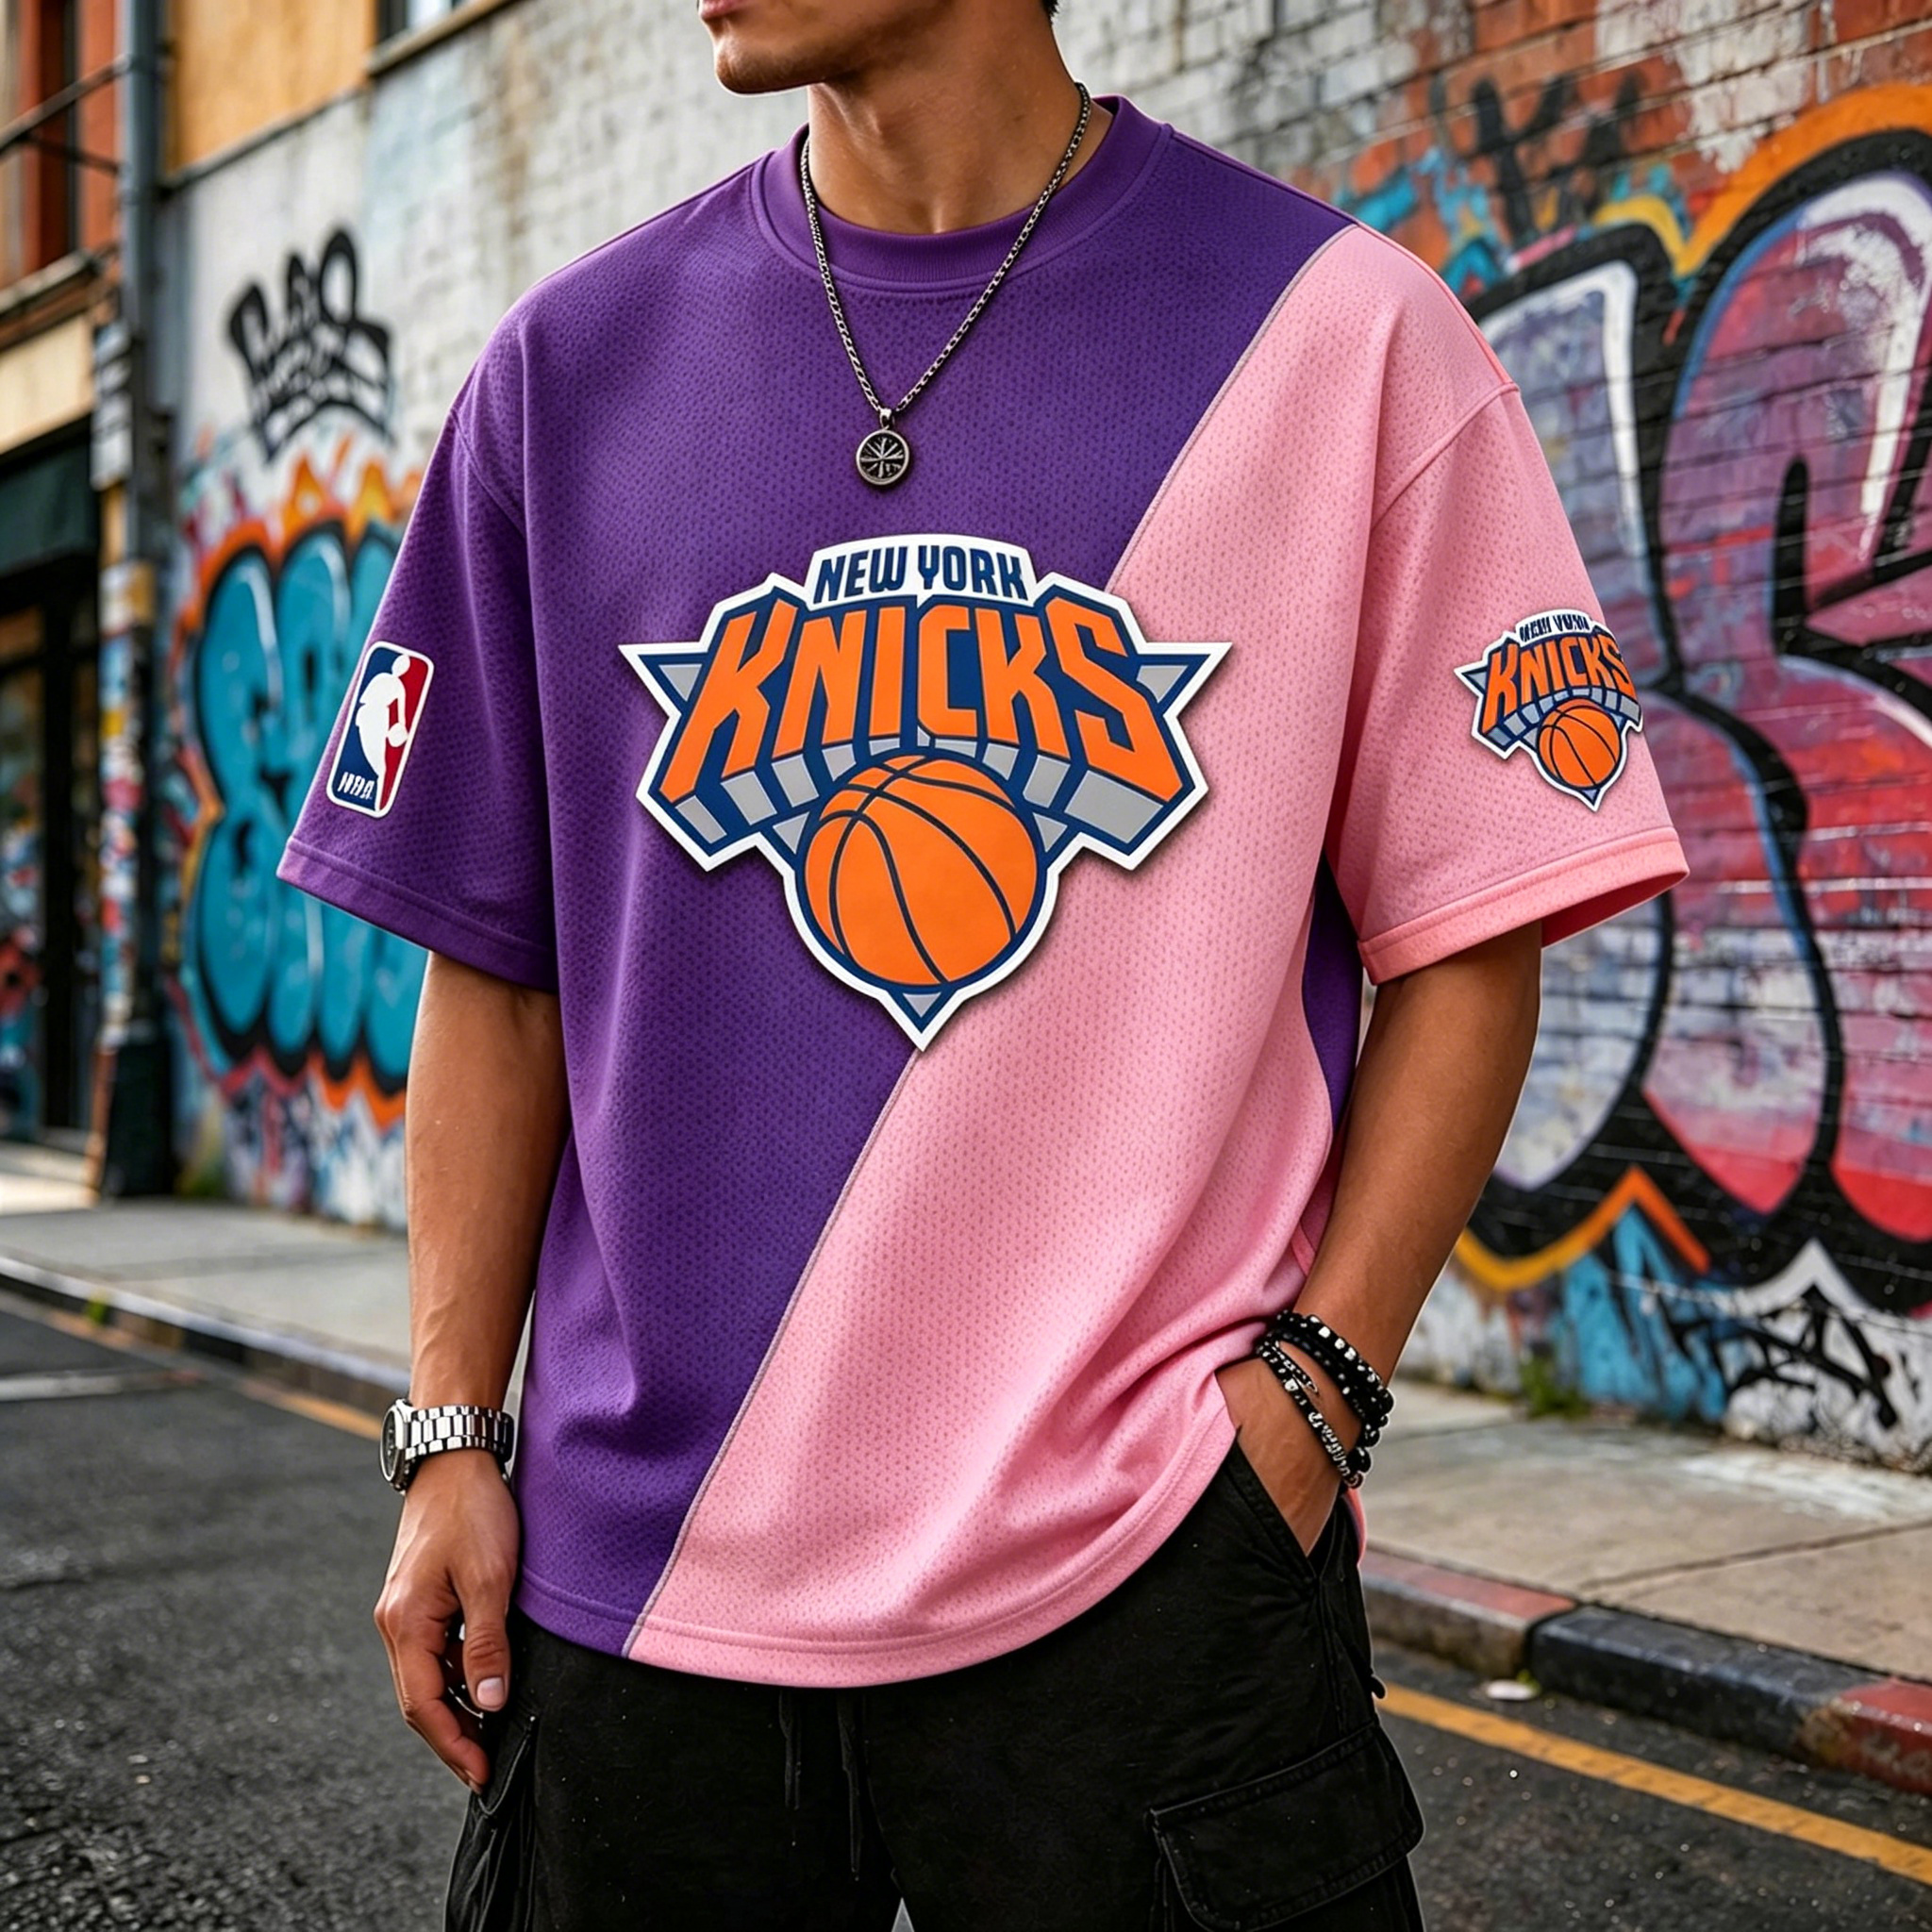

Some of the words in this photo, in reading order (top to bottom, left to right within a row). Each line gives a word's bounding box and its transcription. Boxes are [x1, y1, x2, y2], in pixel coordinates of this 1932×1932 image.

[813, 547, 908, 604] NEW
[917, 544, 1028, 600] YORK
[658, 596, 1184, 803] KNICKS
[1481, 634, 1638, 734] KNICKS
